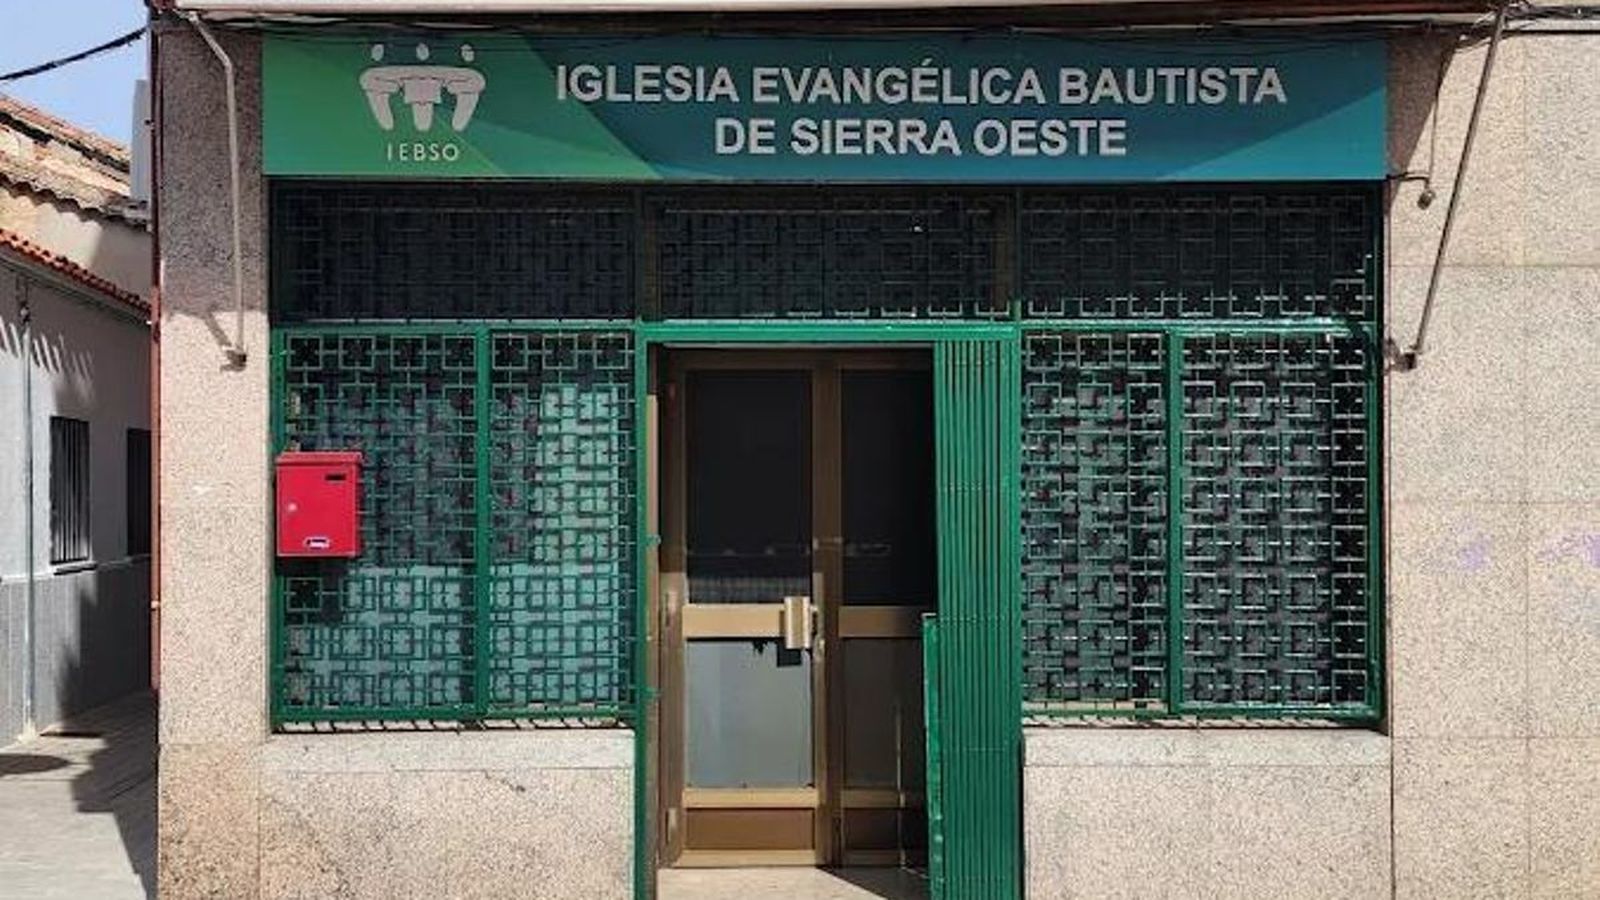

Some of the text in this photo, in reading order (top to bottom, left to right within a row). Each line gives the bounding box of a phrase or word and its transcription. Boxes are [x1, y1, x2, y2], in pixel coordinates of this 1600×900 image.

[557, 58, 1287, 105] IGLESIA EVANGÉLICA BAUTISTA
[386, 142, 461, 162] IEBSO
[715, 117, 1127, 157] DE SIERRA OESTE
